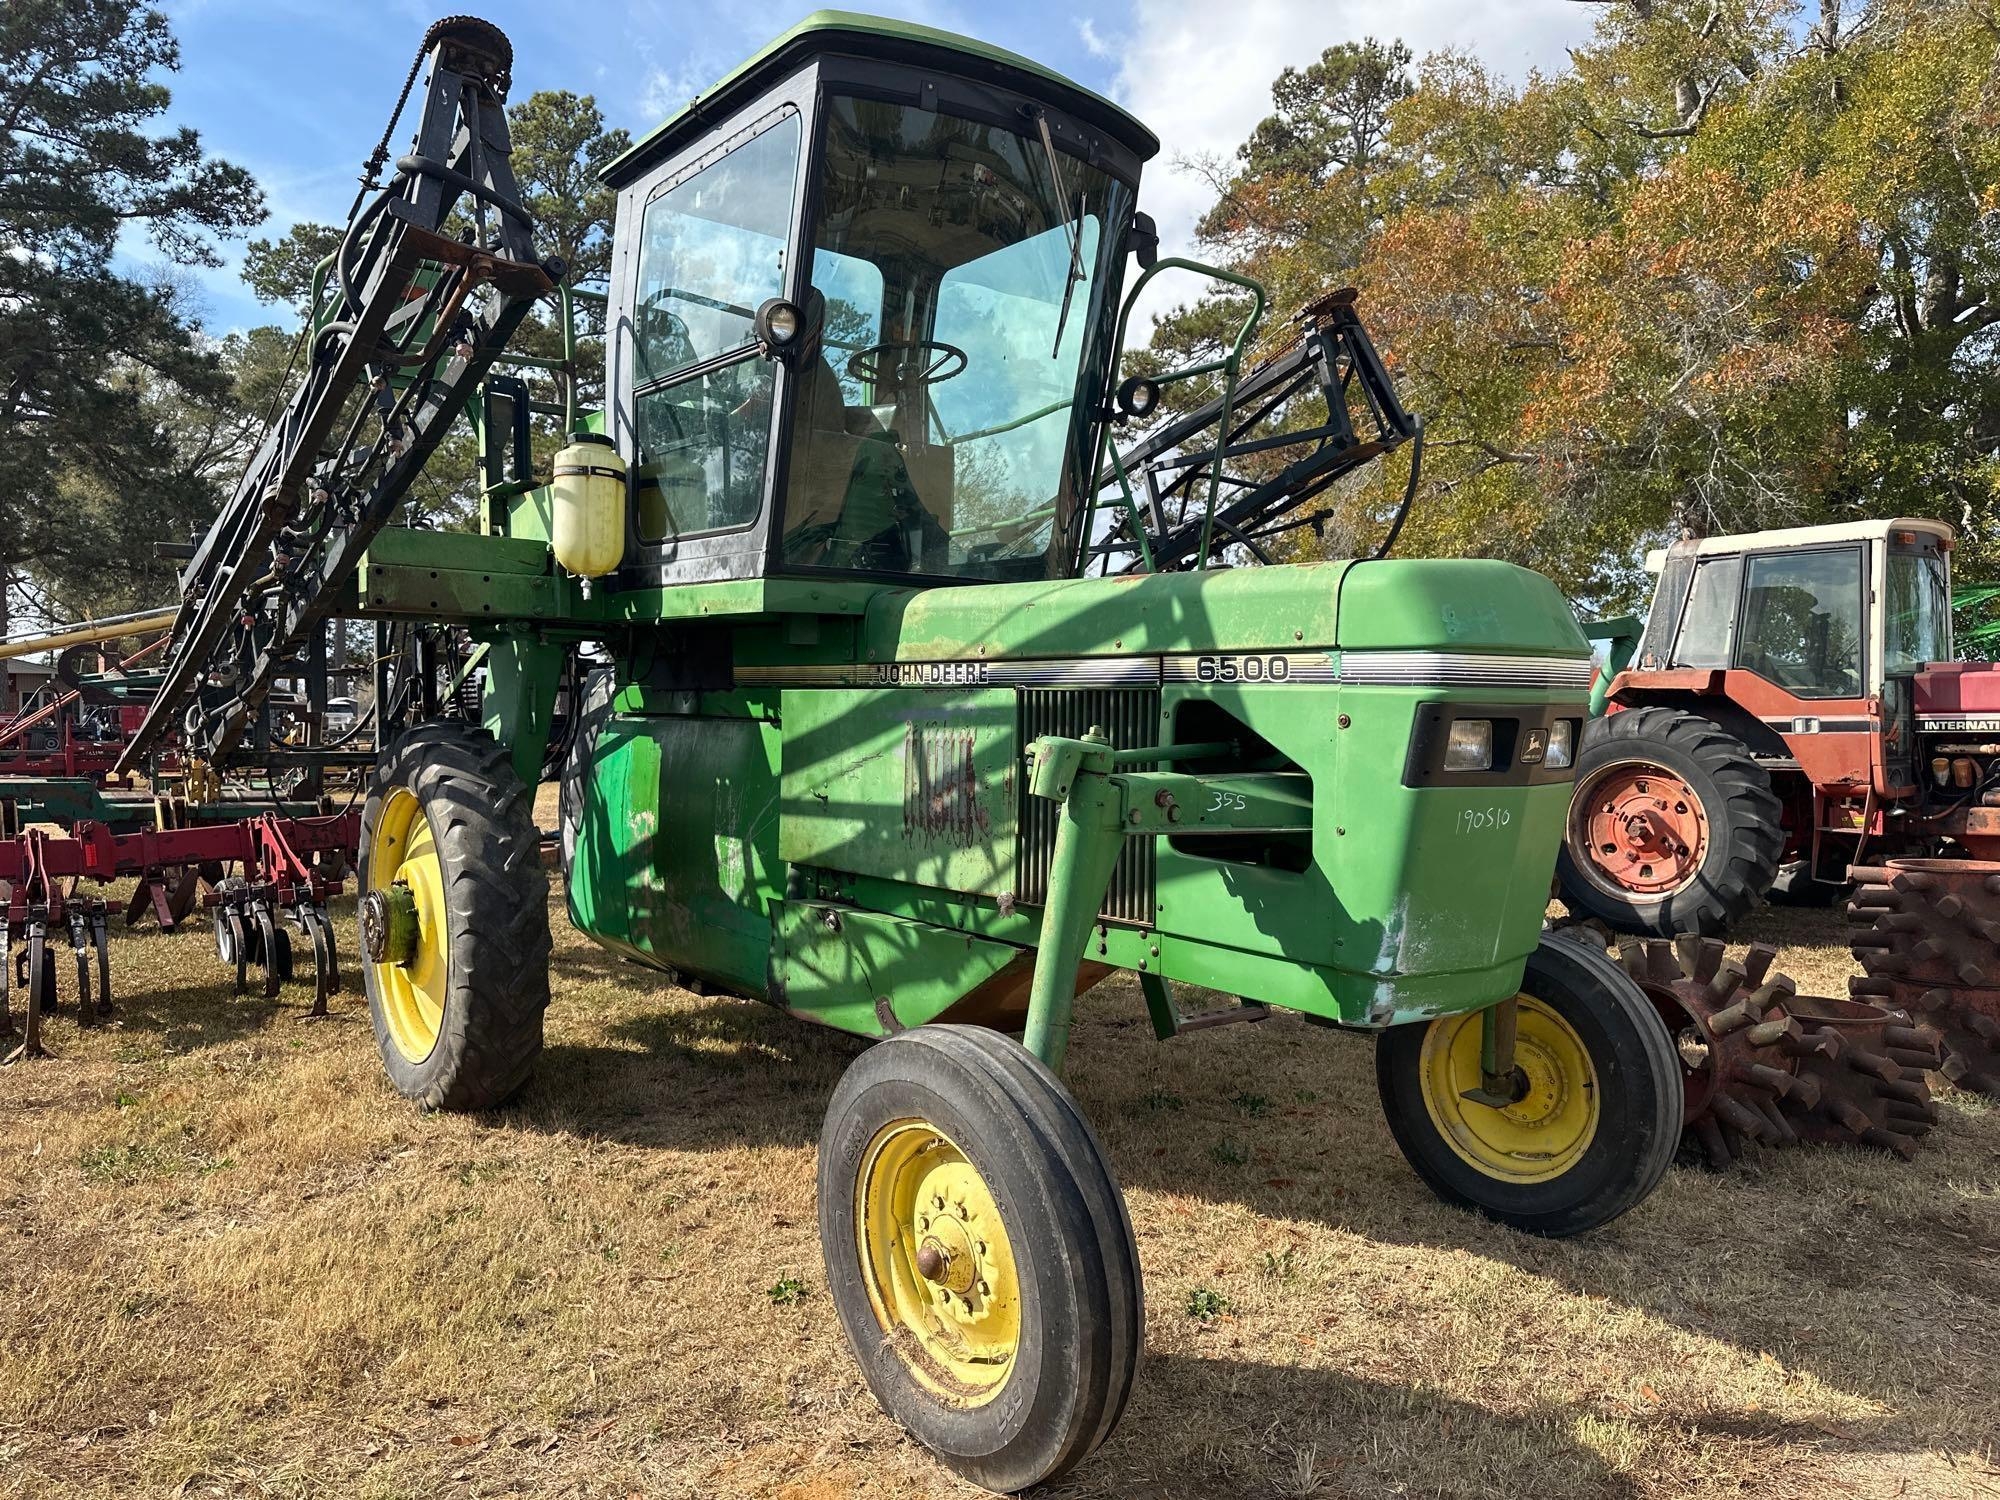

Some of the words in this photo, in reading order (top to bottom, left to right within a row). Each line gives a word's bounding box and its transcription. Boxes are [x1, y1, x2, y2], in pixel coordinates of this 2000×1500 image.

[878, 663, 925, 684] JOHN
[930, 662, 989, 684] DEERE
[1196, 655, 1290, 682] 6500
[1924, 720, 2000, 730] INTERNATI
[1456, 807, 1510, 835] 190510
